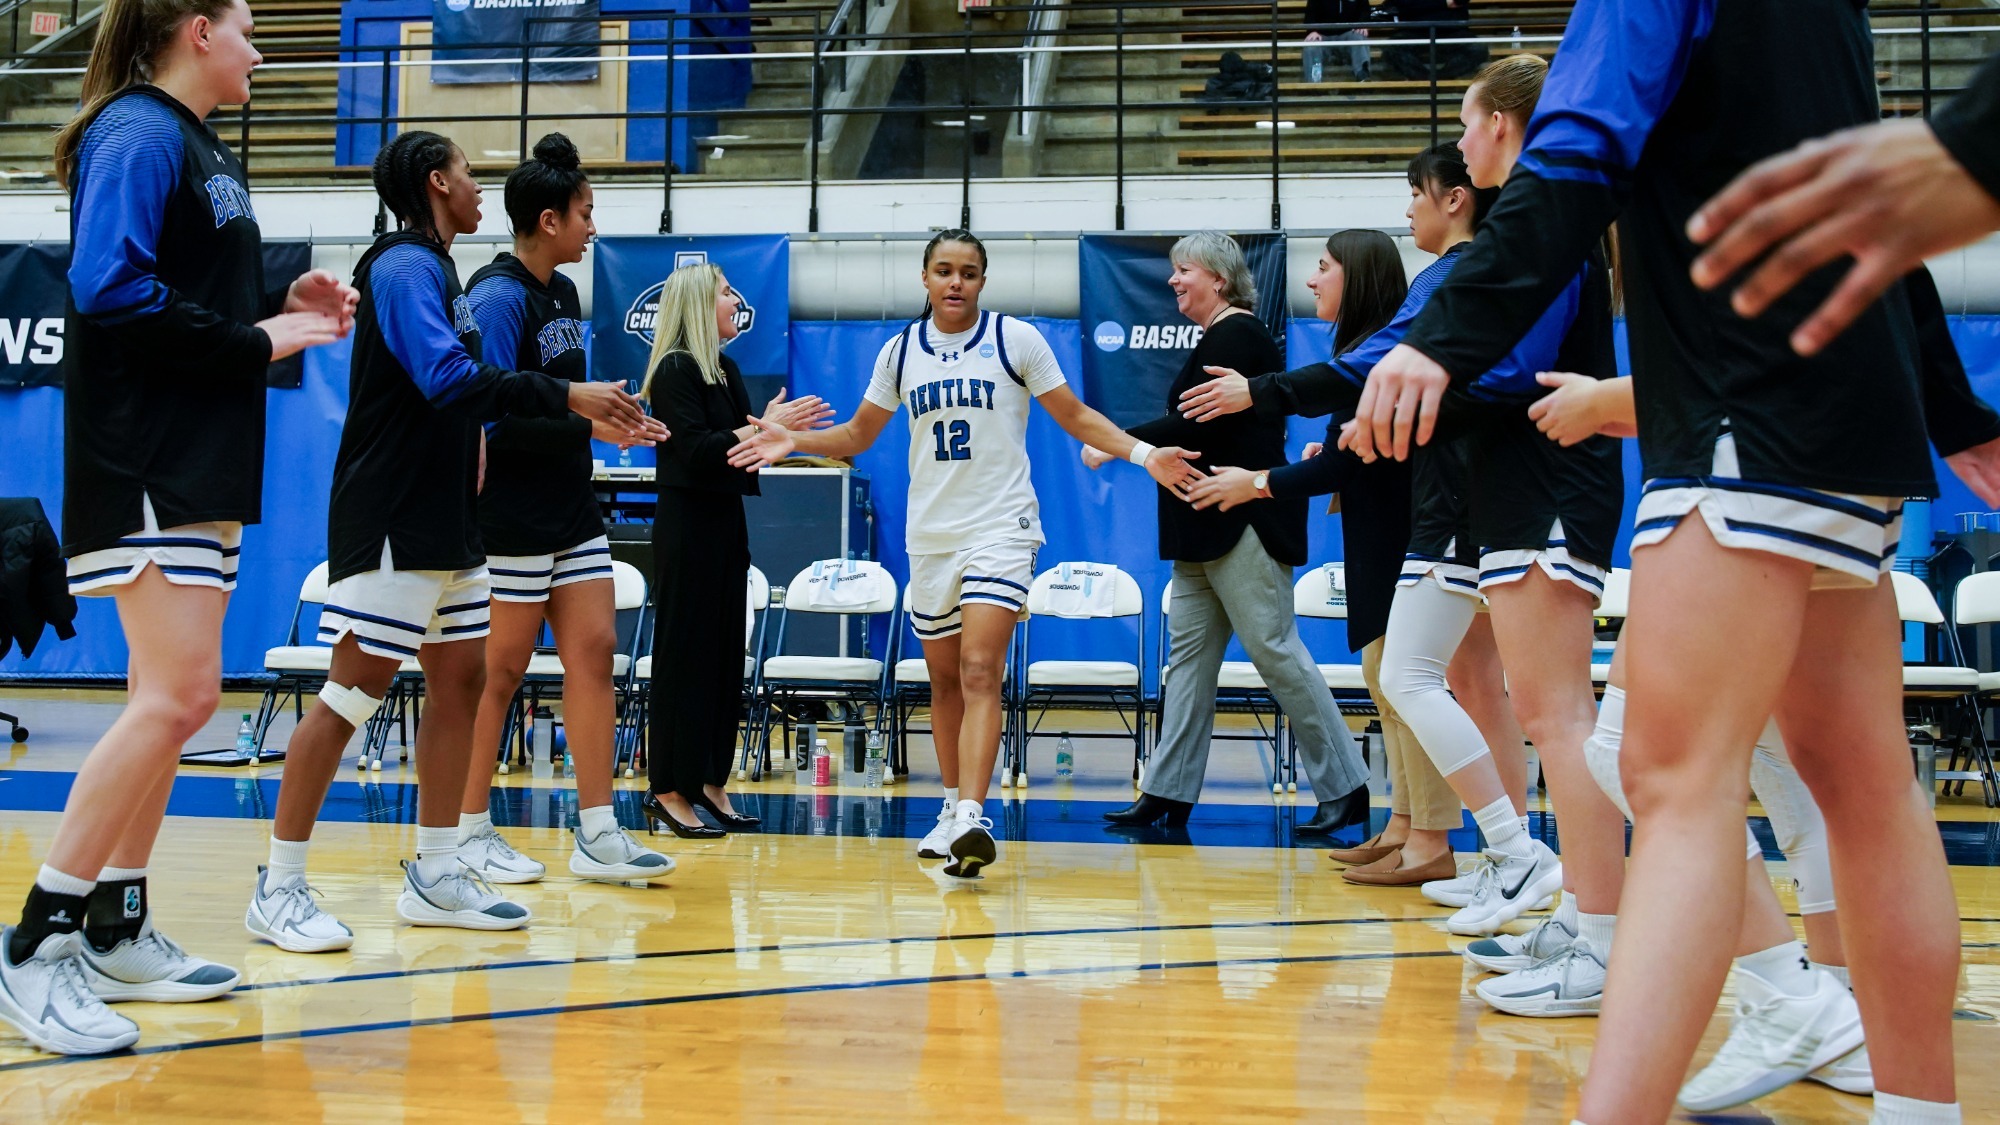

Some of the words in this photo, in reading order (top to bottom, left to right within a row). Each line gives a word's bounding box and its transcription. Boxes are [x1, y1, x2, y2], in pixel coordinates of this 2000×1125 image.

[34, 14, 58, 33] EXIT
[1097, 335, 1125, 345] NCAA
[909, 378, 996, 420] BENTLEY
[932, 419, 972, 461] 12
[837, 572, 868, 583] POWERADE
[1048, 583, 1080, 591] POWERADE
